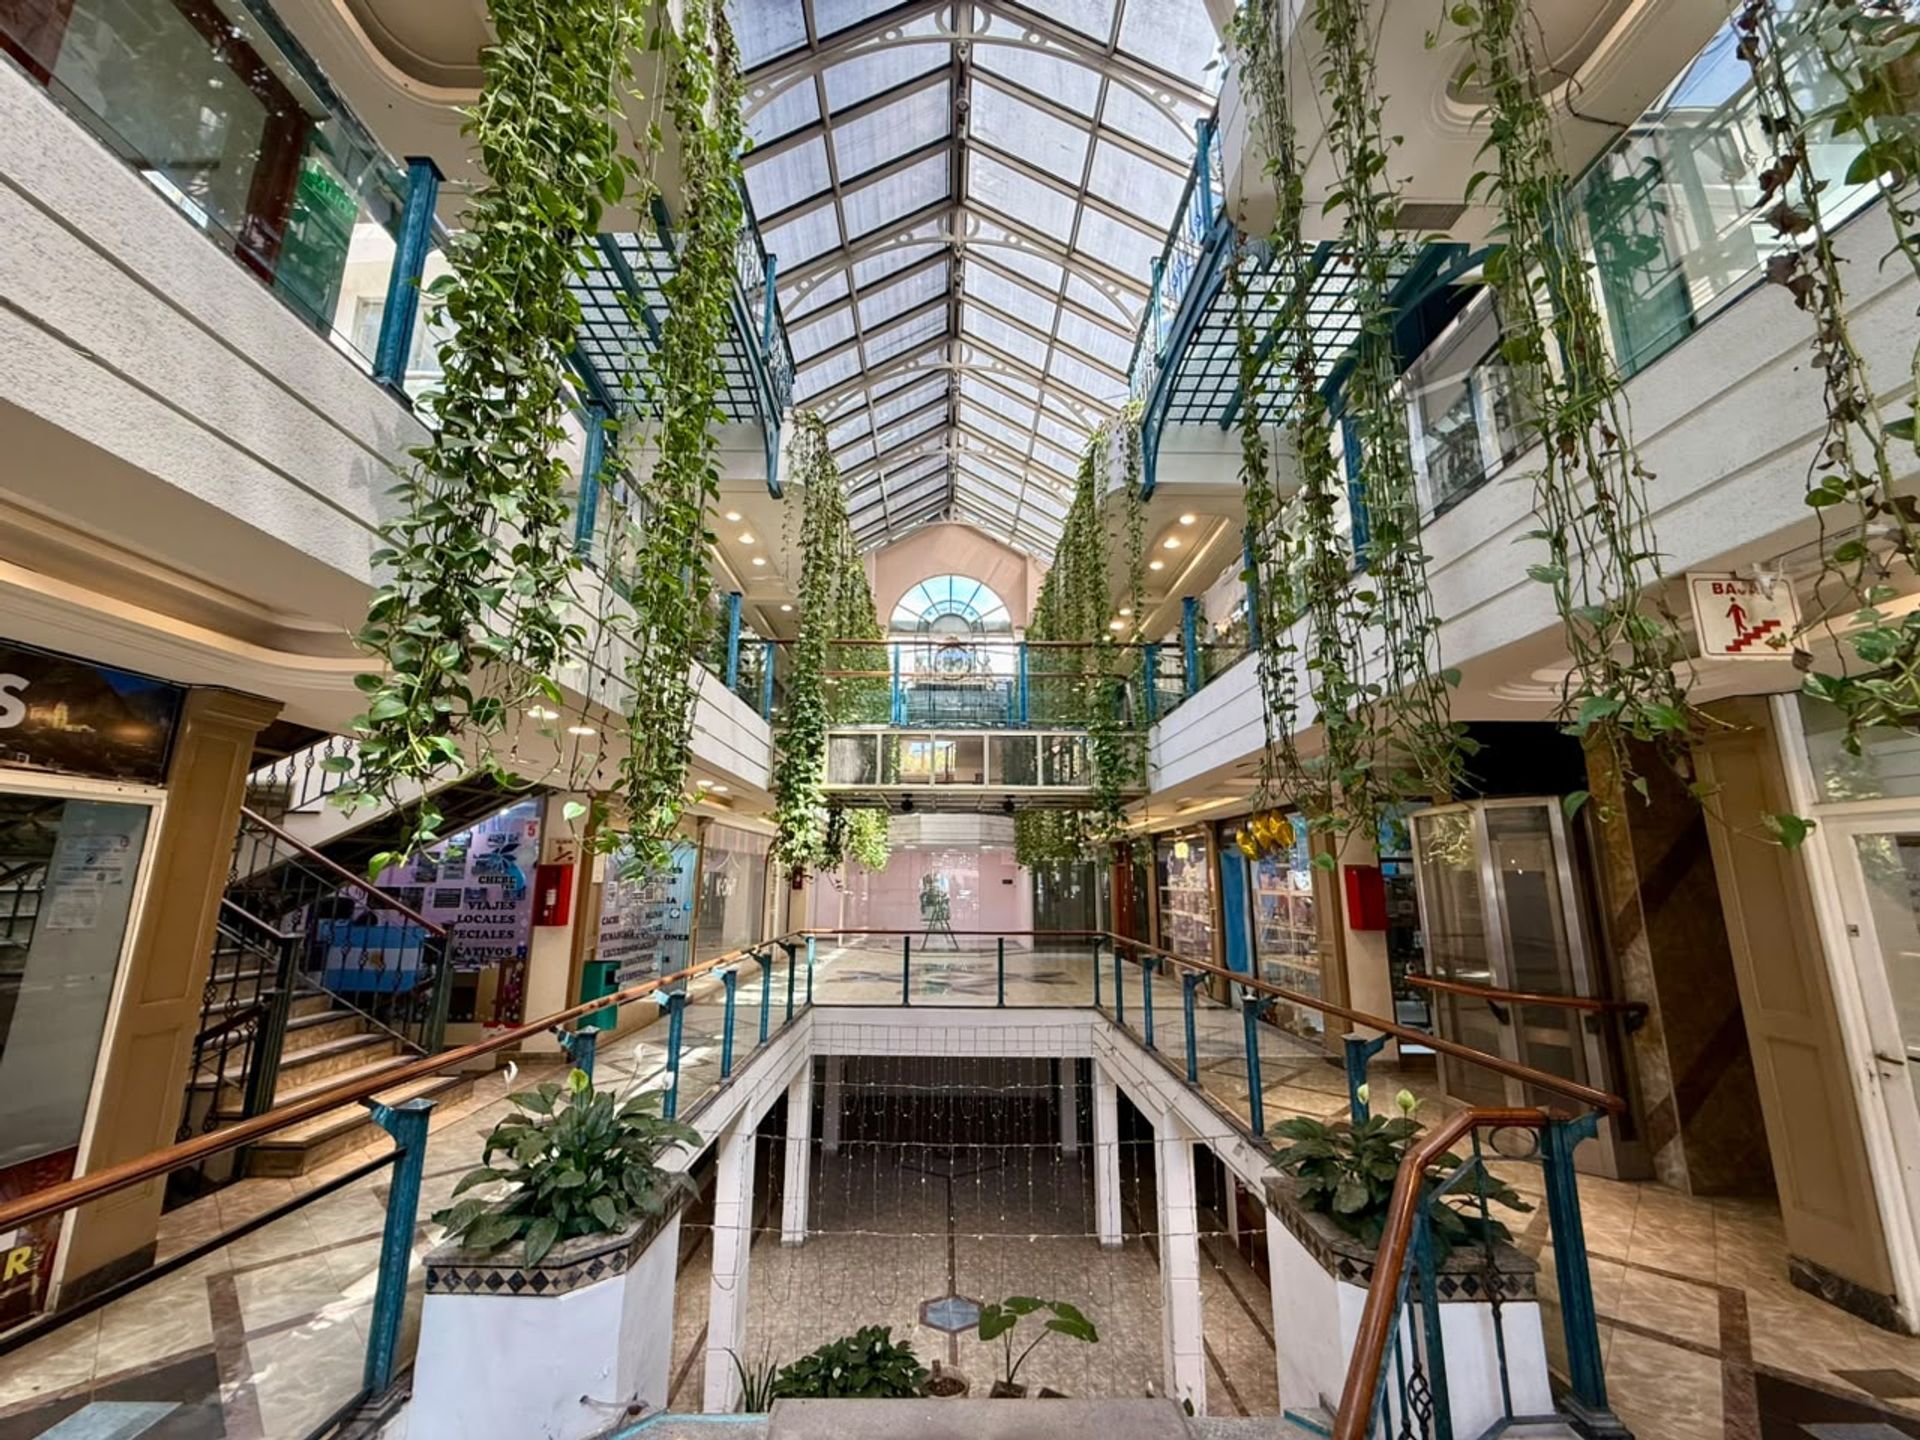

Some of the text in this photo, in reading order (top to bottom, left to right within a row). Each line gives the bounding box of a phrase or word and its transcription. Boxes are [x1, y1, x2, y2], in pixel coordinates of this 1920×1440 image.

[1711, 582, 1764, 595] BAA
[468, 901, 516, 910] VIAJES
[457, 914, 516, 924] LOCALES
[454, 946, 513, 957] CATIVOS
